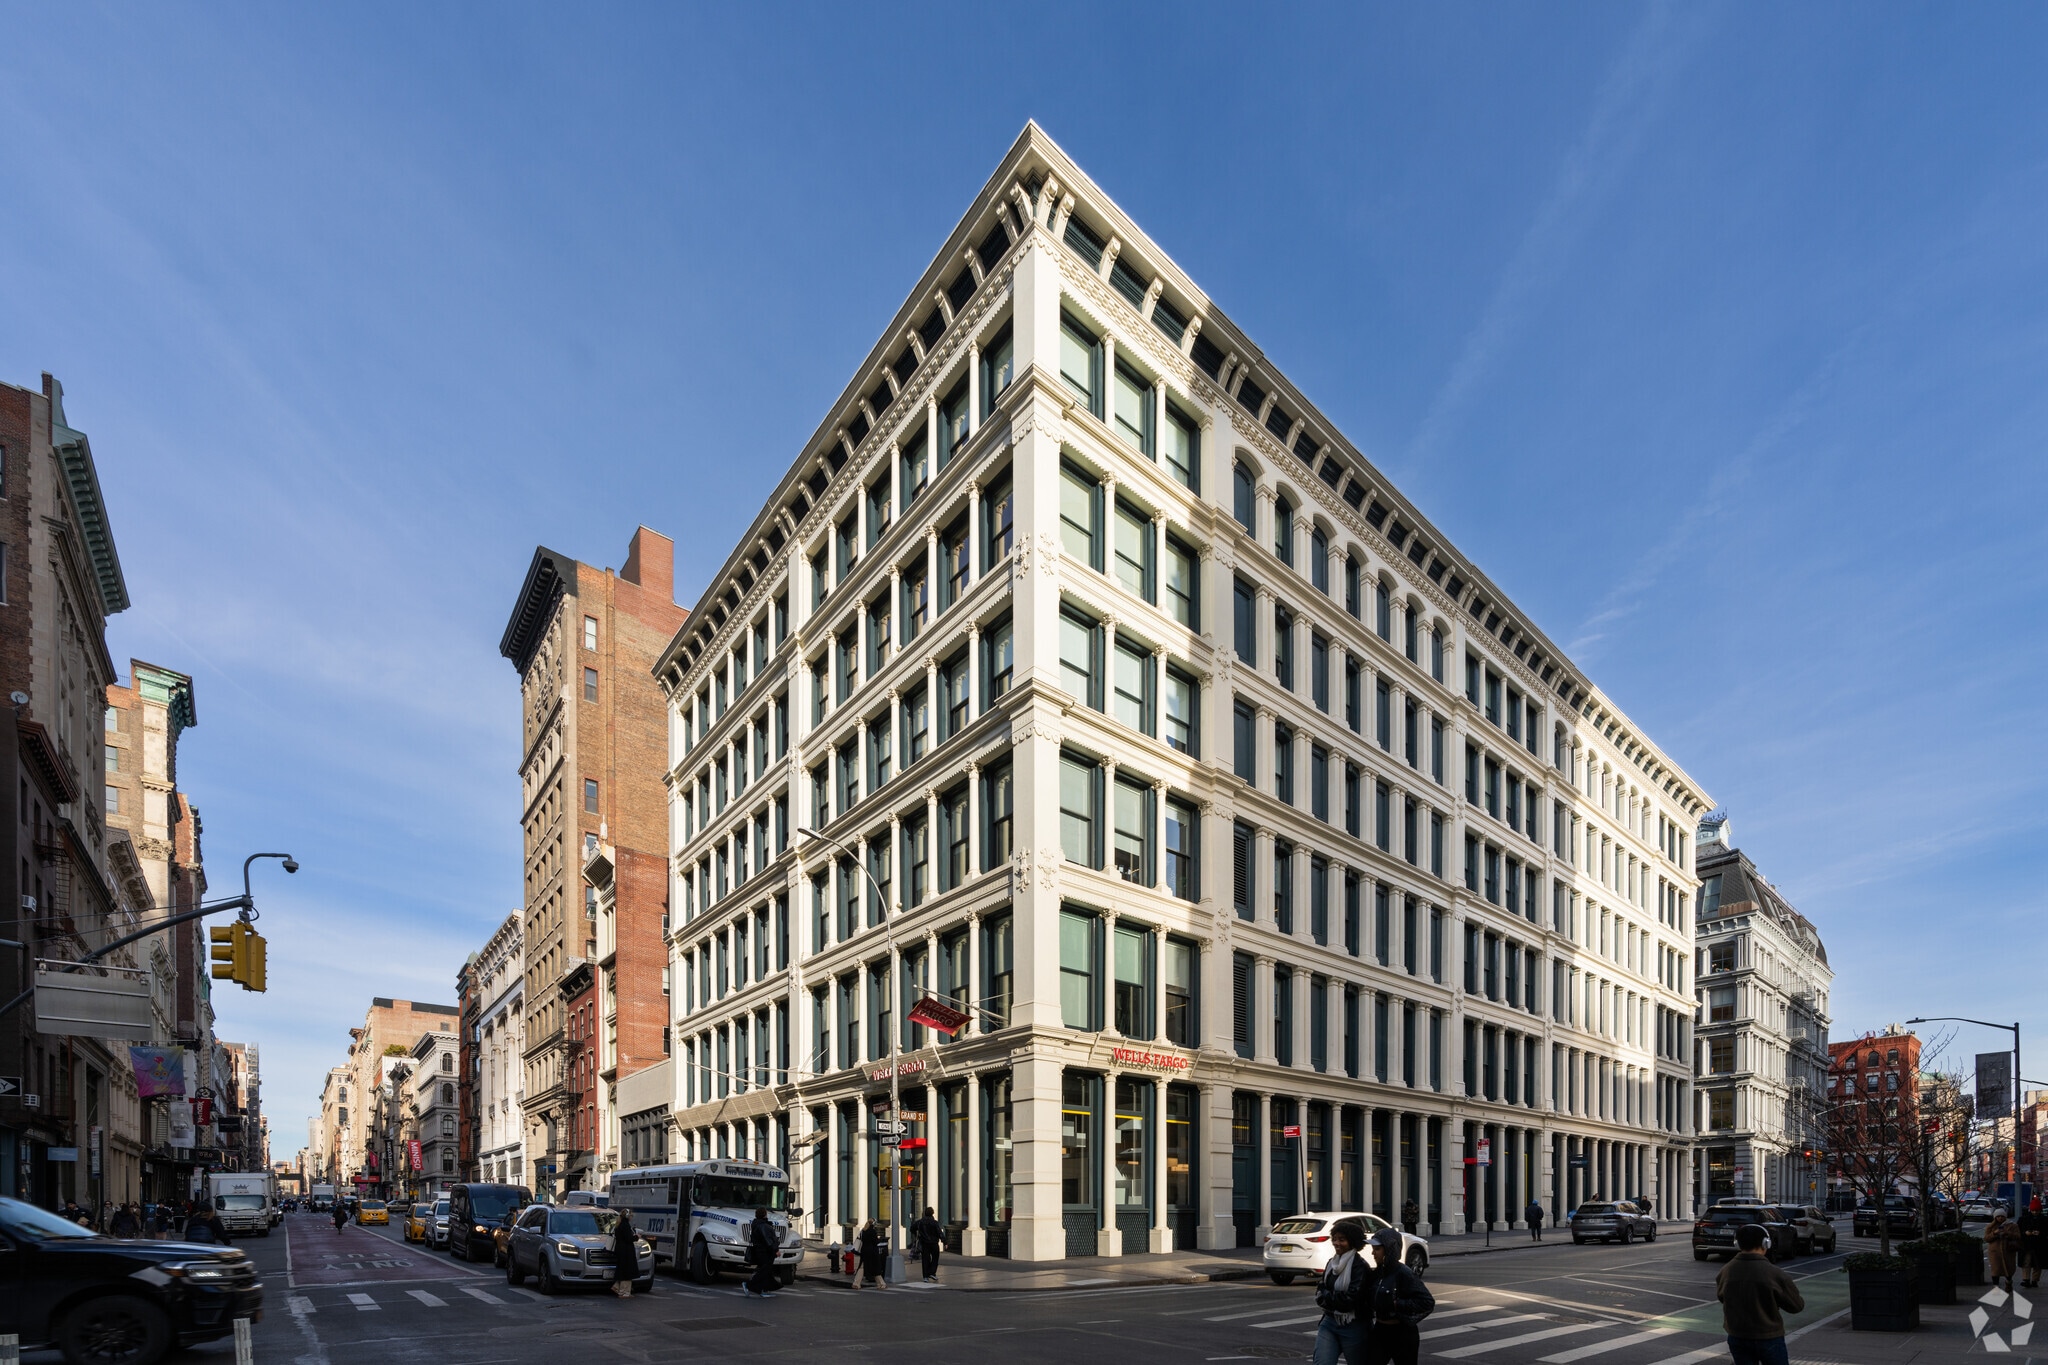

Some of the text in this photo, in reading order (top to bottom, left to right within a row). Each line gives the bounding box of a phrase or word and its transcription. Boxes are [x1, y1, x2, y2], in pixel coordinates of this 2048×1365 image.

[917, 1009, 954, 1027] FARGO
[925, 1001, 962, 1020] WELLS
[1113, 1048, 1188, 1069] WELLS FARGO
[872, 1067, 893, 1081] WELL
[901, 1112, 925, 1121] GRAND ST
[410, 1141, 422, 1170] MINISO
[648, 1218, 664, 1232] NYCD
[323, 1259, 416, 1270] ONLY
